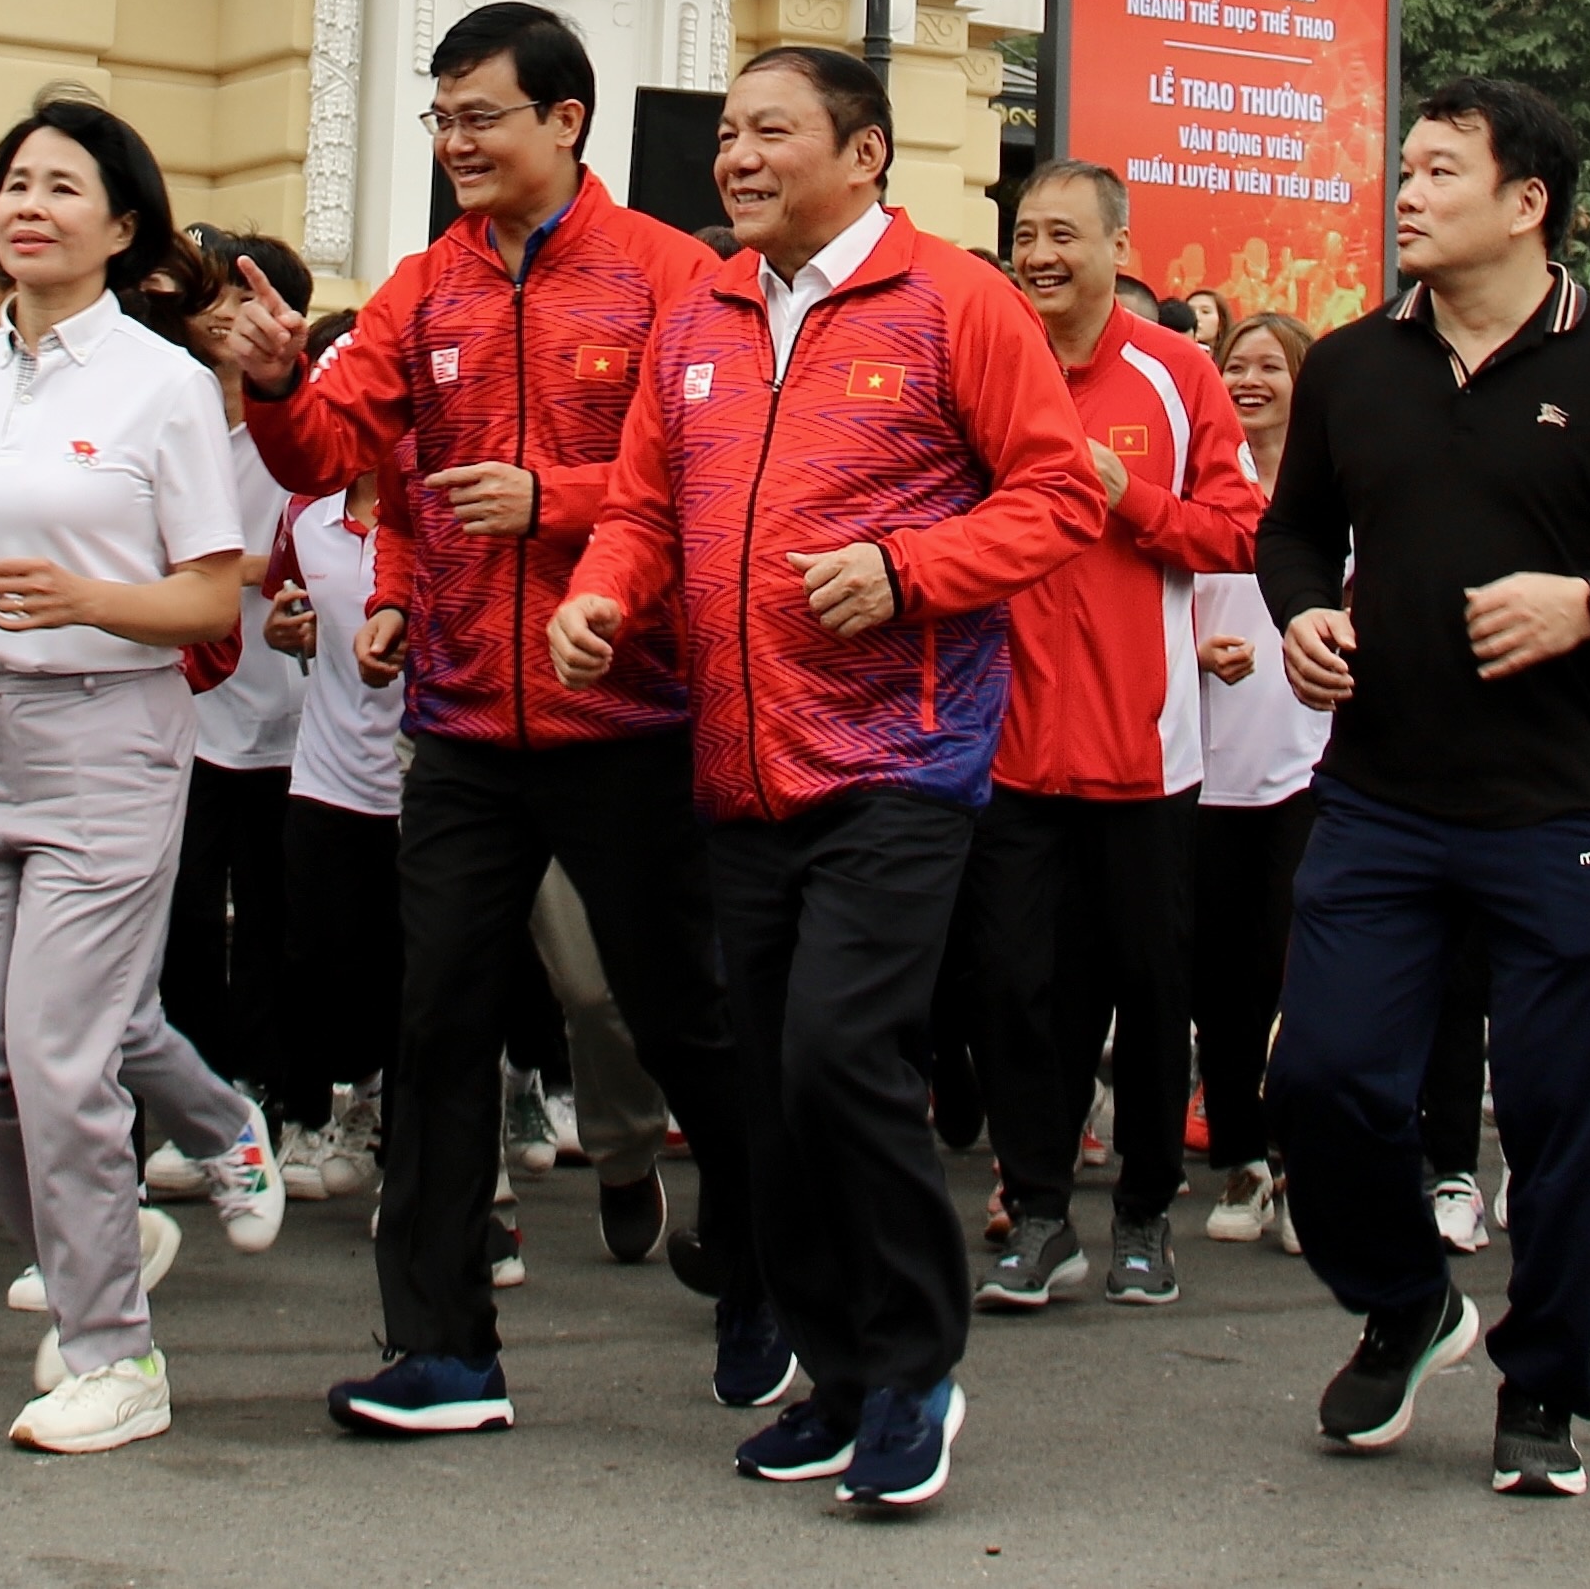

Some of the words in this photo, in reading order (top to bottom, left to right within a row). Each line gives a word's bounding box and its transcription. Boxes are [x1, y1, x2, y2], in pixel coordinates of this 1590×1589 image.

[1223, 7, 1257, 34] DỤC
[1260, 5, 1292, 35] THỂ
[1294, 15, 1335, 42] THAO
[1149, 66, 1175, 105] LỄ
[1180, 77, 1235, 112] TRAO
[1240, 81, 1323, 122] THƯỞNG
[1179, 123, 1213, 154] VẬN
[1217, 127, 1262, 158] ĐỘNG
[1266, 133, 1304, 161] VIÊN
[1127, 154, 1174, 185] HUẤN
[1178, 163, 1230, 194] LUYỆN
[1234, 167, 1272, 195] VIÊN
[1276, 172, 1310, 199] TIÊU
[1314, 172, 1351, 204] BIỂU
